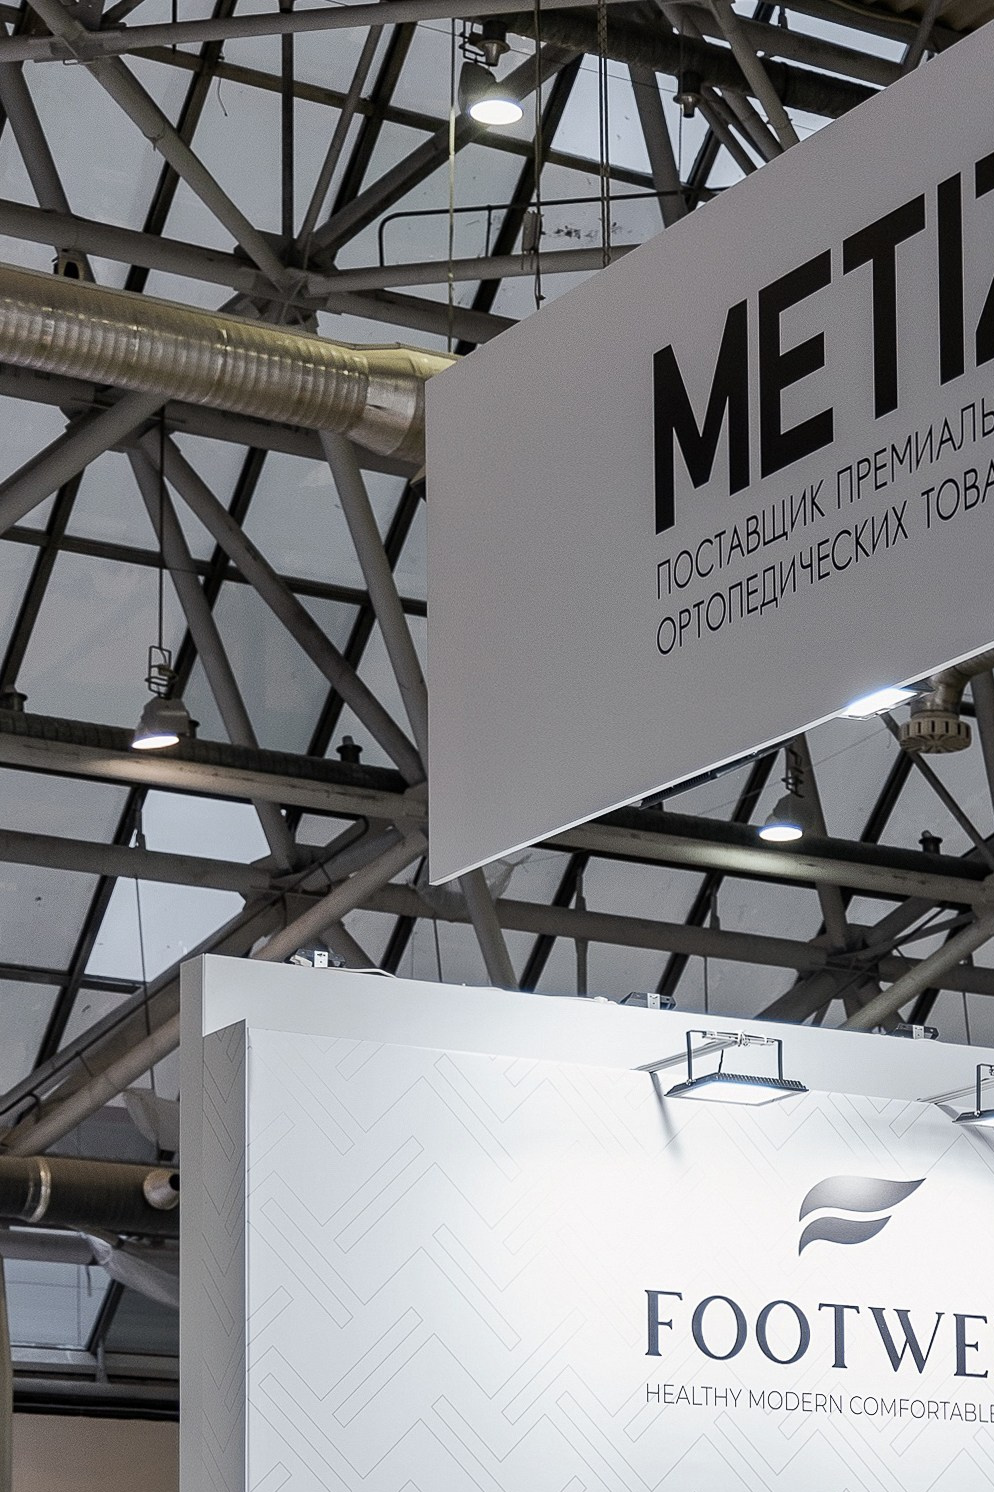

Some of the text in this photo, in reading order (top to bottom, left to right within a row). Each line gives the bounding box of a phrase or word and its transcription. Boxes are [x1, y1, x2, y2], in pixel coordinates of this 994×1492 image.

[656, 479, 827, 601] ПОСТАВЩИК
[656, 501, 909, 655] ОРТОПЕДИЧЕСКИХ
[646, 1382, 742, 1408] HEALTHY
[749, 1389, 843, 1414] MODERN
